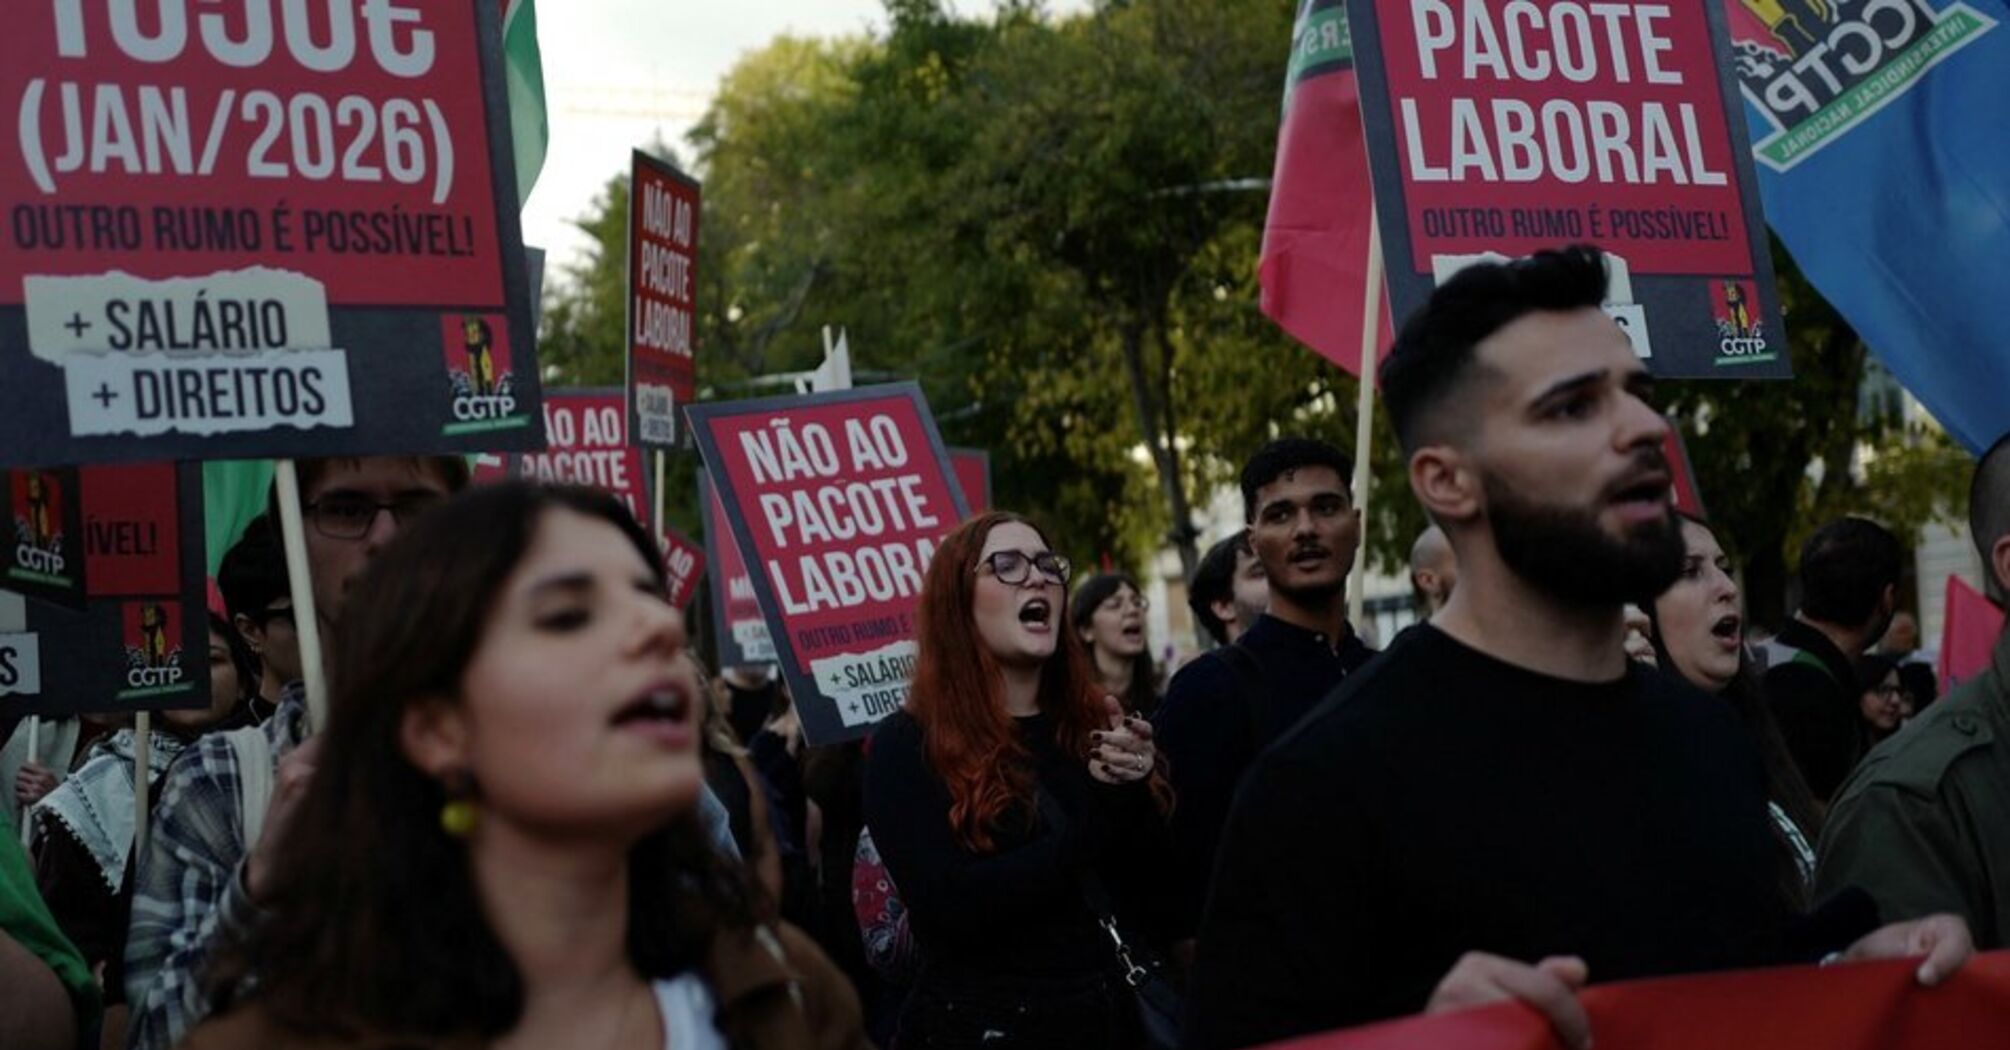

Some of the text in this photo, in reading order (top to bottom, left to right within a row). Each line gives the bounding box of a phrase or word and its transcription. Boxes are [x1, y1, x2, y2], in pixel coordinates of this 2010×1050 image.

[1413, 0, 1683, 84] PACOTE
[18, 78, 454, 204] (JAN/2026)
[1401, 98, 1727, 185] LABORAL
[13, 200, 475, 256] OUTRO RUMO É POSSÍVEL!
[643, 179, 692, 249] NÃO AO
[1423, 203, 1728, 241] OUTRO RUMO É POSSÍVEL!
[641, 240, 691, 302] PACOTE
[106, 290, 288, 350] SALÁRIO
[635, 294, 693, 358] LABORAL
[1720, 338, 1766, 354] CGTP
[133, 368, 325, 419] DIREITOS
[453, 396, 516, 420] CGTP
[583, 404, 622, 447] AO
[738, 418, 840, 484] NÃO
[845, 414, 908, 472] AO
[758, 474, 939, 548] PACOTE
[16, 544, 65, 575] CGTP
[769, 534, 948, 615] LABORA
[798, 624, 851, 651] OUTRO
[852, 616, 898, 641] RUMO
[128, 667, 183, 687] CGTP
